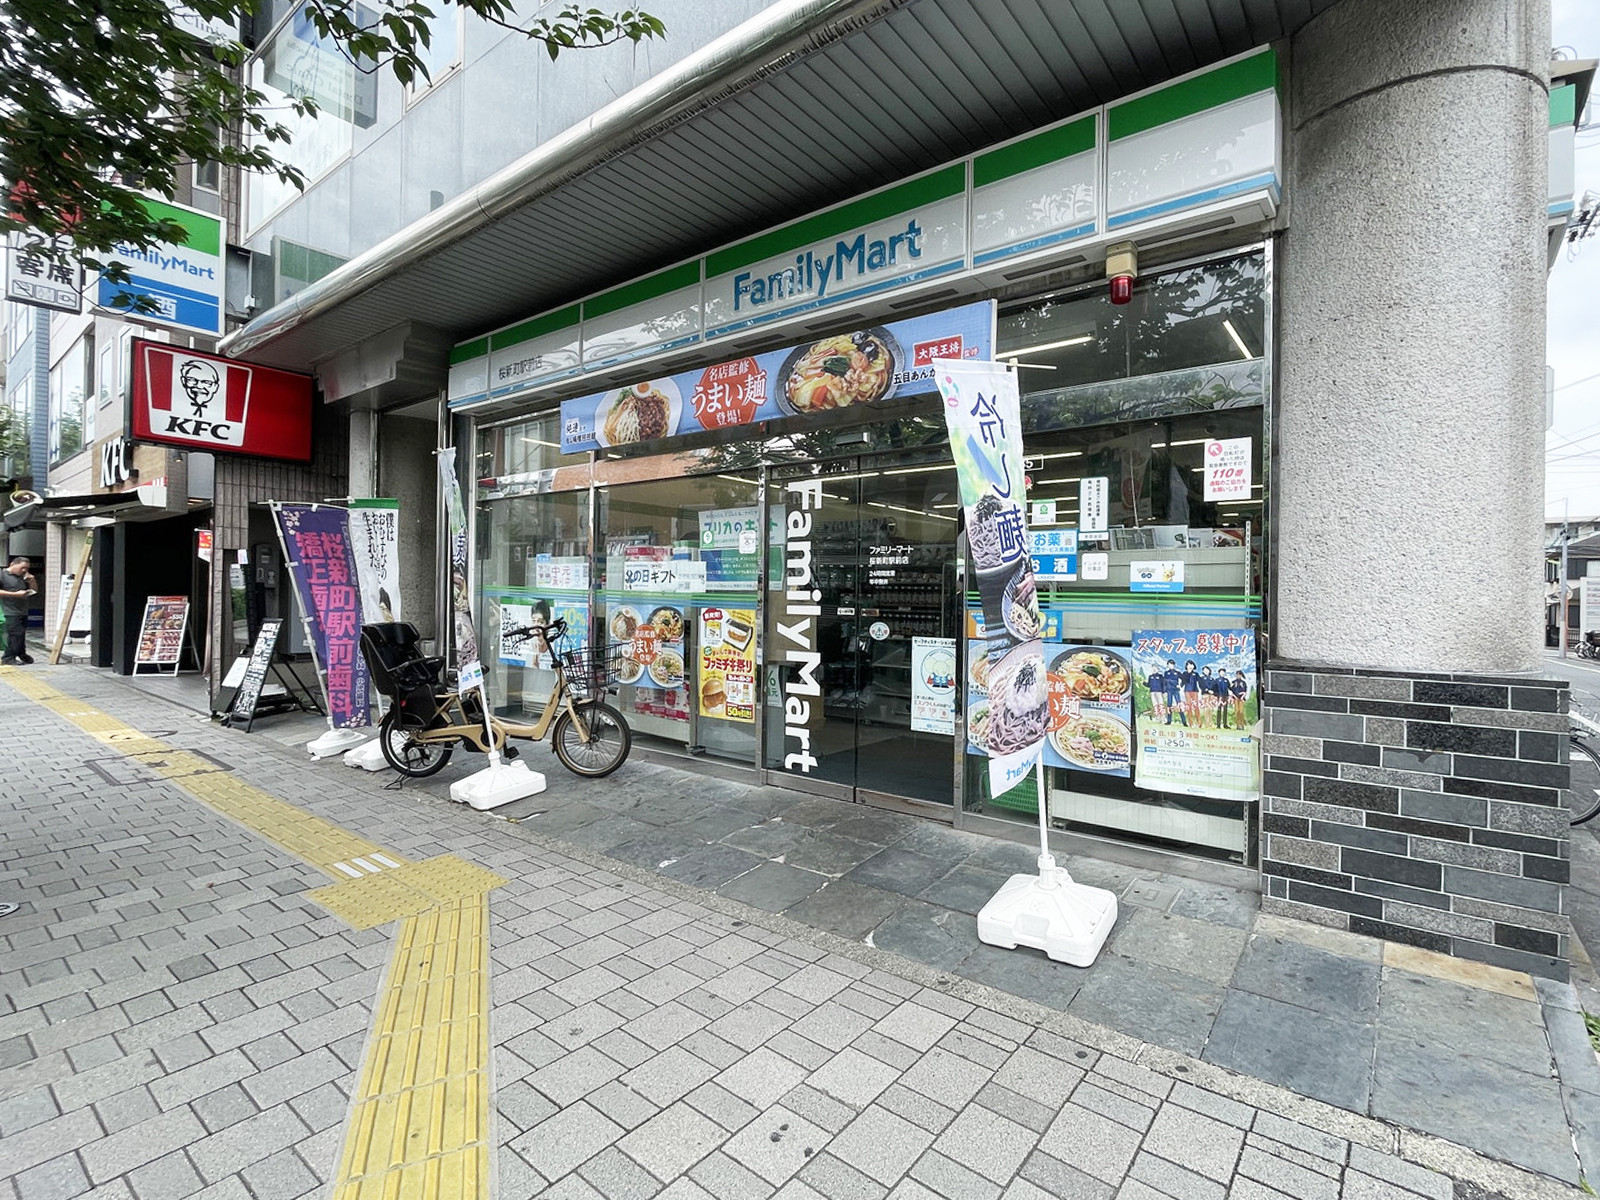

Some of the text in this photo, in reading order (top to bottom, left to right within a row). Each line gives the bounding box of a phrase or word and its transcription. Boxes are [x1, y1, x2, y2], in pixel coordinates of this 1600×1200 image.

[112, 242, 214, 281] amilyMart
[733, 218, 923, 311] FamilyMart
[918, 341, 960, 359] 大阪王将
[498, 355, 543, 380] 桜新町駅前店
[709, 360, 750, 382] 名店監修
[691, 370, 768, 418] うまい麺
[165, 415, 231, 441] KFC
[716, 408, 742, 426] 登場!
[100, 436, 130, 489] KFC
[869, 545, 914, 555] ファミリーマート
[1034, 532, 1061, 547] お薬
[776, 480, 823, 774] FamilyMart
[703, 656, 753, 673] ファミチキ祭り
